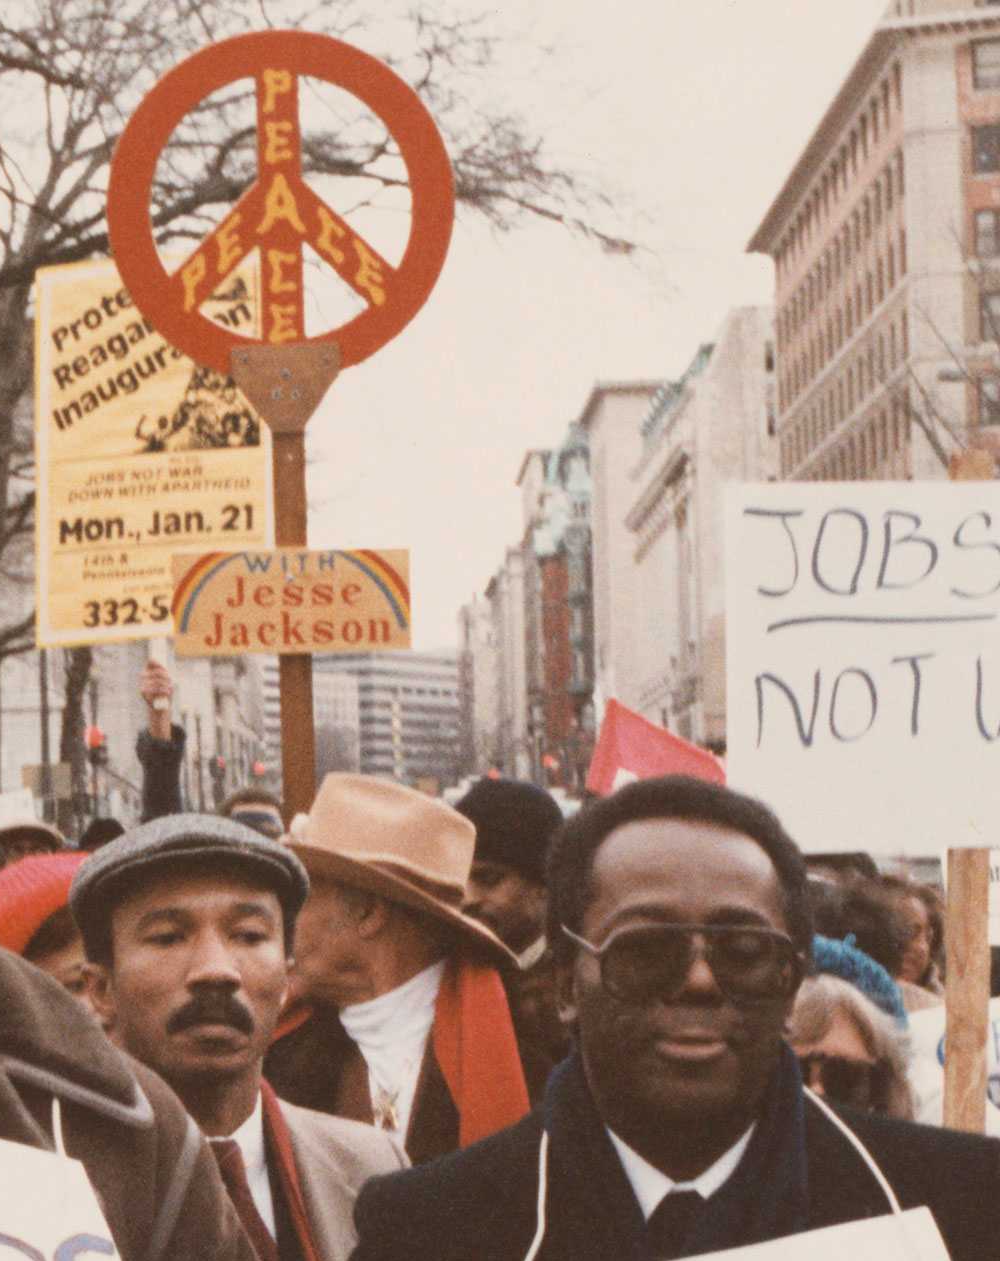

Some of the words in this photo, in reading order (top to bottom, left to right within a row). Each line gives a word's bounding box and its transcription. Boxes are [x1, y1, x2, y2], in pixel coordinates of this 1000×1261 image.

[256, 67, 307, 343] PEACE
[51, 287, 133, 353] Prote
[59, 512, 142, 545] Mon.,
[147, 504, 213, 537] Jan.
[221, 500, 255, 531] 21
[244, 551, 336, 574] WITH
[743, 507, 1000, 598] JOBS
[82, 593, 169, 628] 332-5
[225, 575, 363, 609] Jesse
[203, 610, 393, 647] Jackson
[754, 652, 936, 750] NOT
